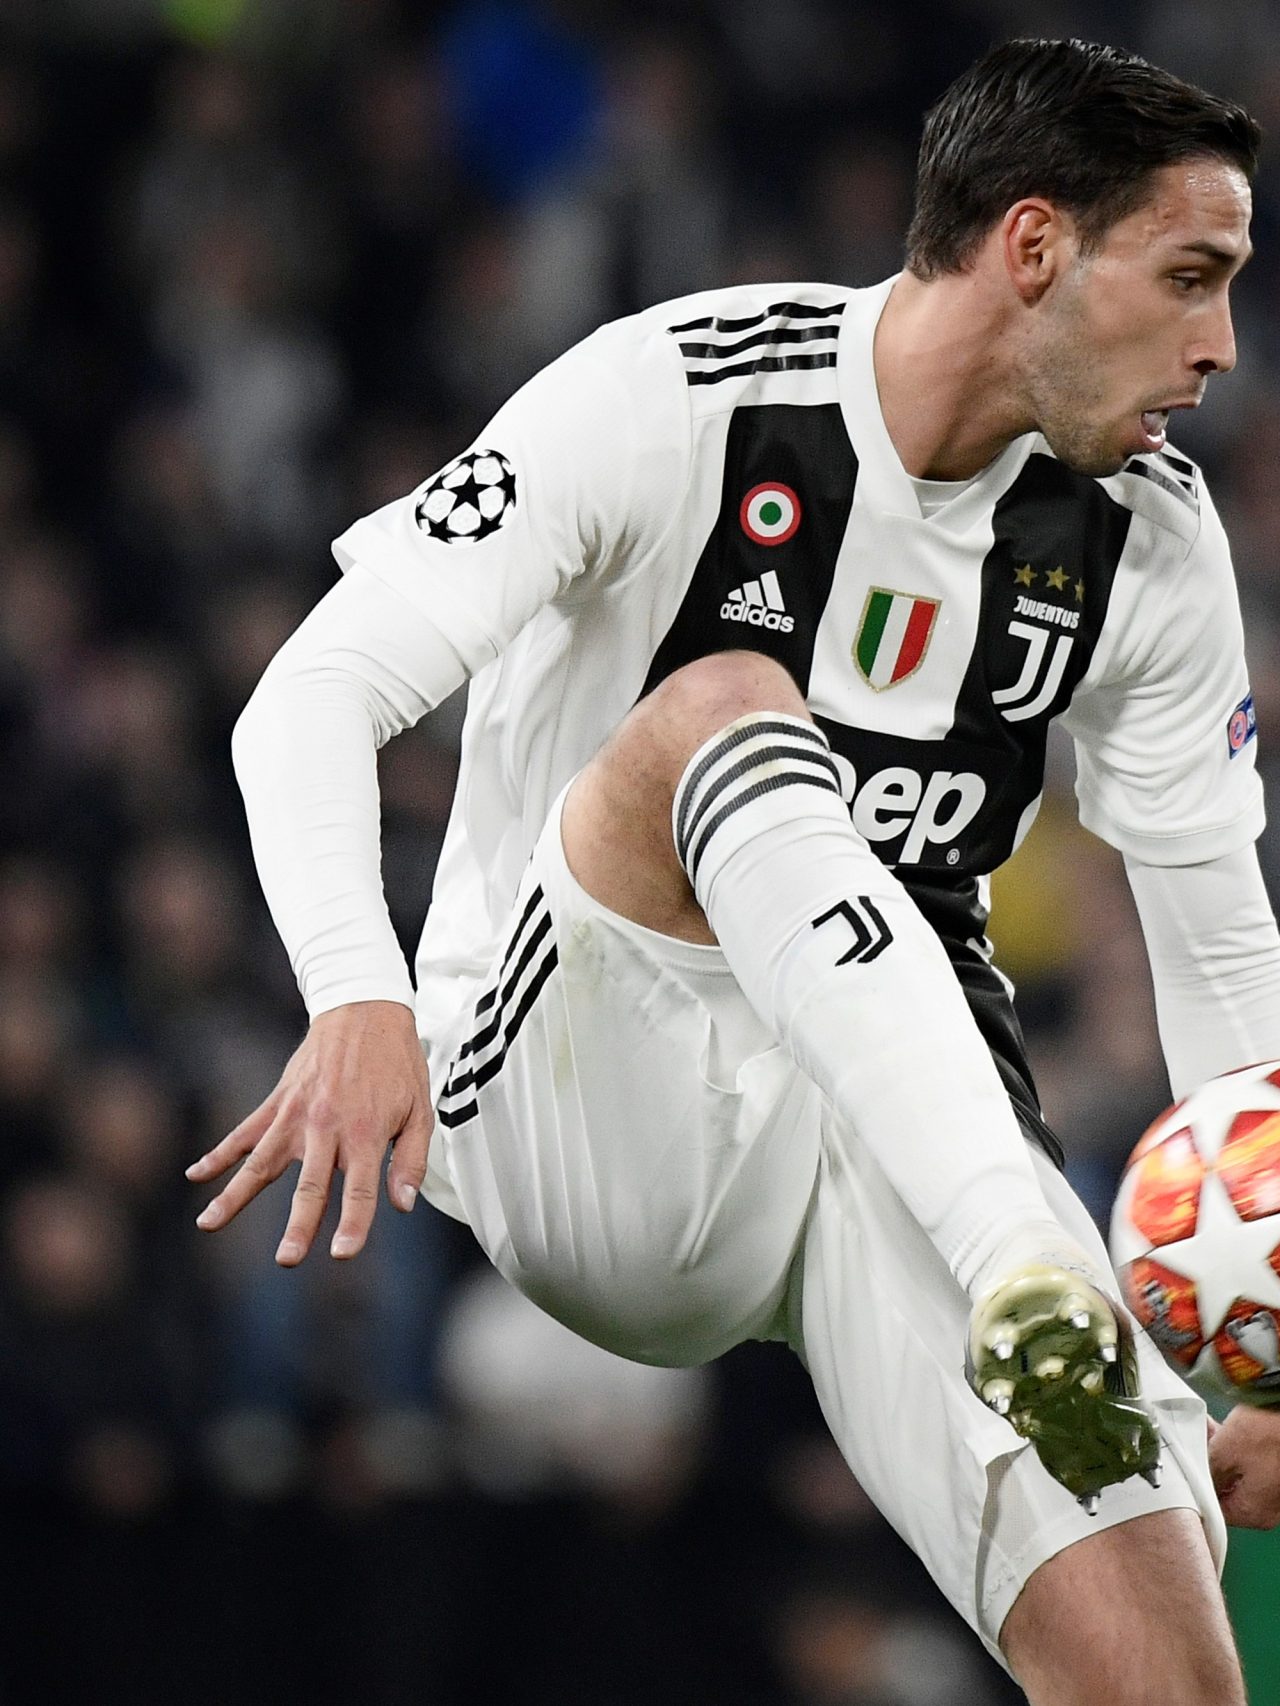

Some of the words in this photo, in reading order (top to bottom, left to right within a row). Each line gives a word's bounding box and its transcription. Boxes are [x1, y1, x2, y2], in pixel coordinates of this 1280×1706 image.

[720, 600, 795, 633] adidas
[1013, 595, 1080, 629] JUVENTUS
[829, 751, 987, 864] ep
